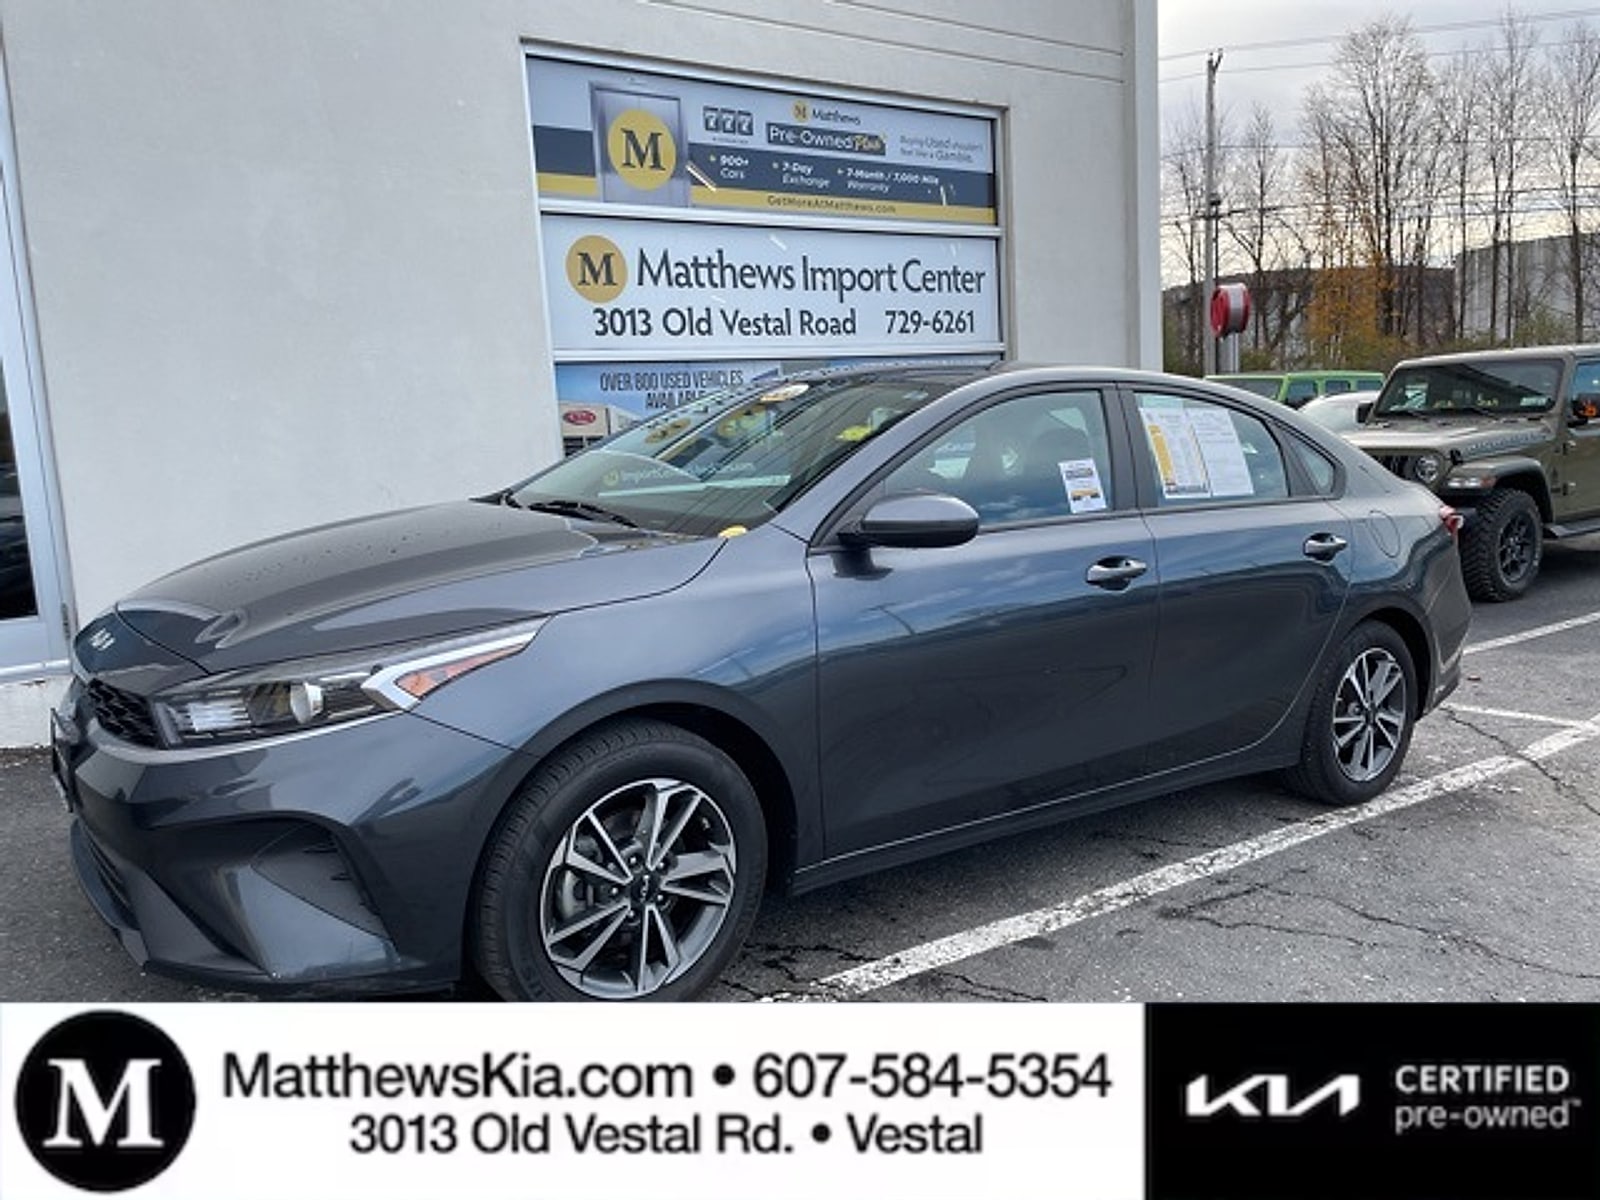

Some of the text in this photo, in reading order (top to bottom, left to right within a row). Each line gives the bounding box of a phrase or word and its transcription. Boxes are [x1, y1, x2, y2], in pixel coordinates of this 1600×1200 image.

[620, 128, 666, 171] M
[720, 154, 749, 167] 900+
[720, 167, 745, 180] Cars
[782, 173, 831, 189] Exchange
[847, 181, 889, 194] Warranty
[577, 252, 618, 286] M
[637, 248, 986, 303] Matthews Import Center
[593, 307, 975, 336] 3013 Old Vestal Road 729-6261
[600, 369, 744, 391] OVER 800 USED VEHICLES
